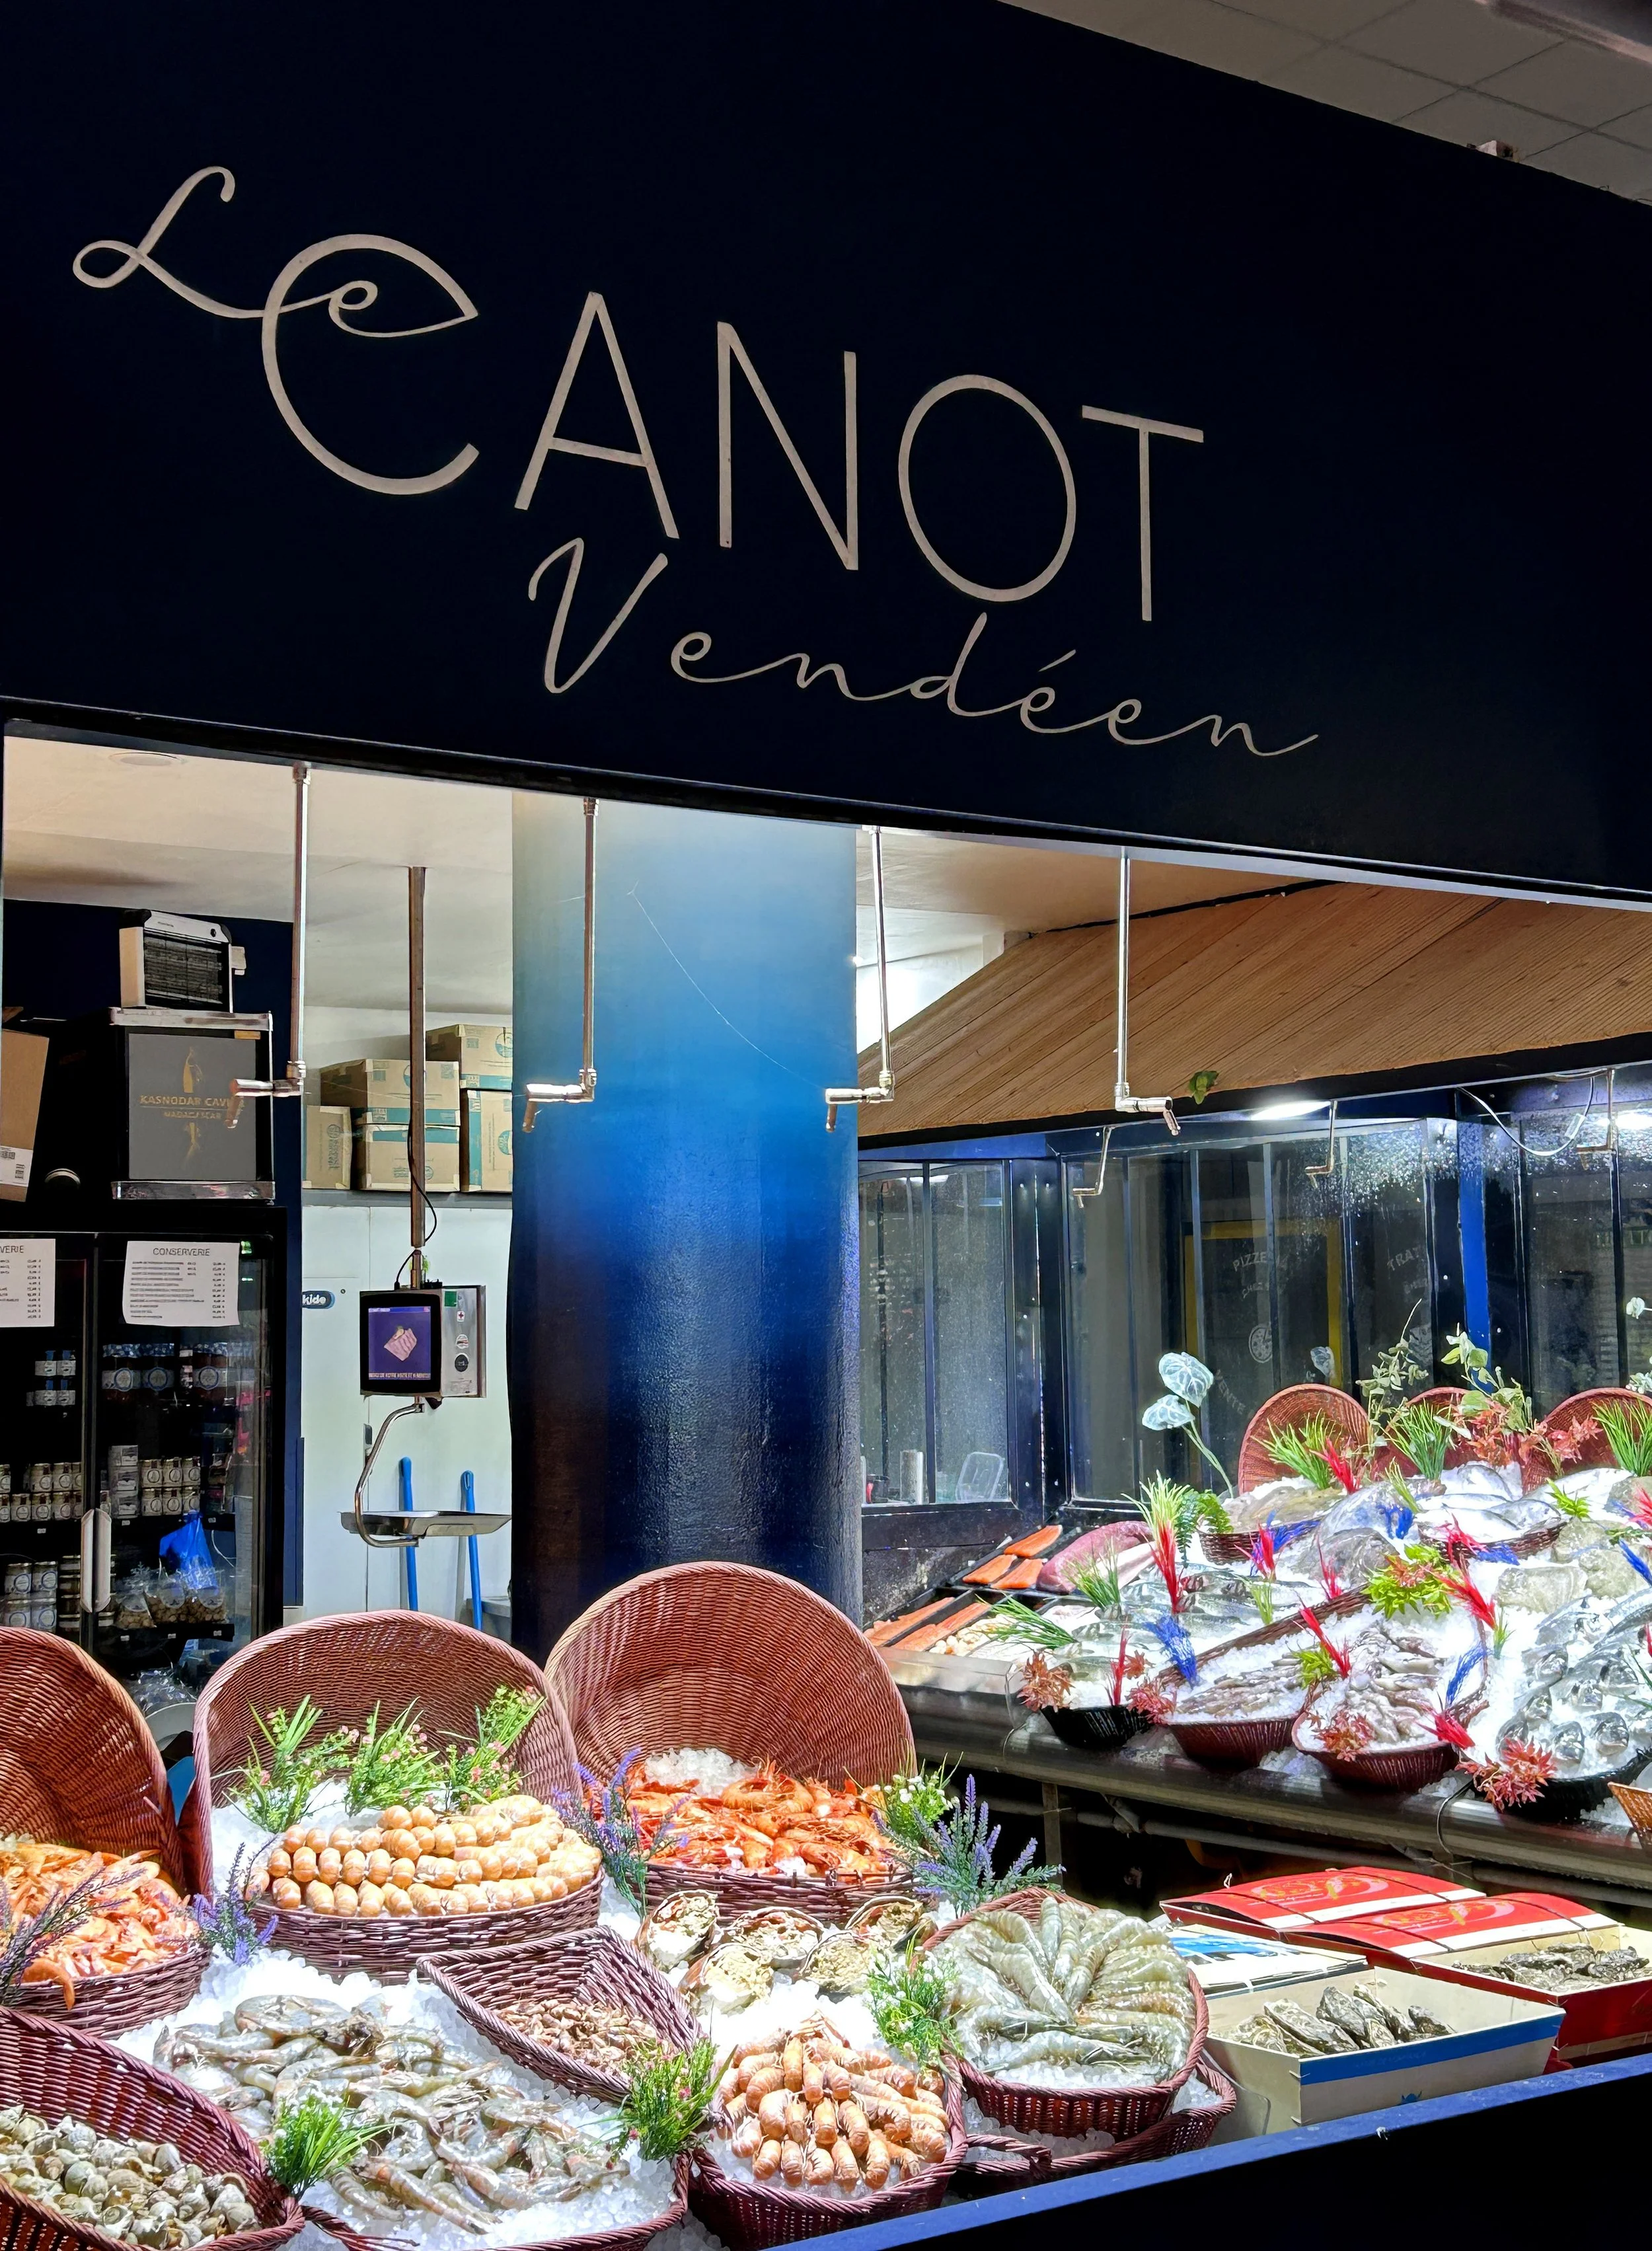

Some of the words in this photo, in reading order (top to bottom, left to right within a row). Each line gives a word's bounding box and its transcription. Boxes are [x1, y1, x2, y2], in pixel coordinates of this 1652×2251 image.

[73, 167, 380, 337] Le
[262, 234, 1203, 621] CANOT
[529, 538, 1318, 756] Vendéen
[153, 1247, 211, 1256] CONSERVERIE
